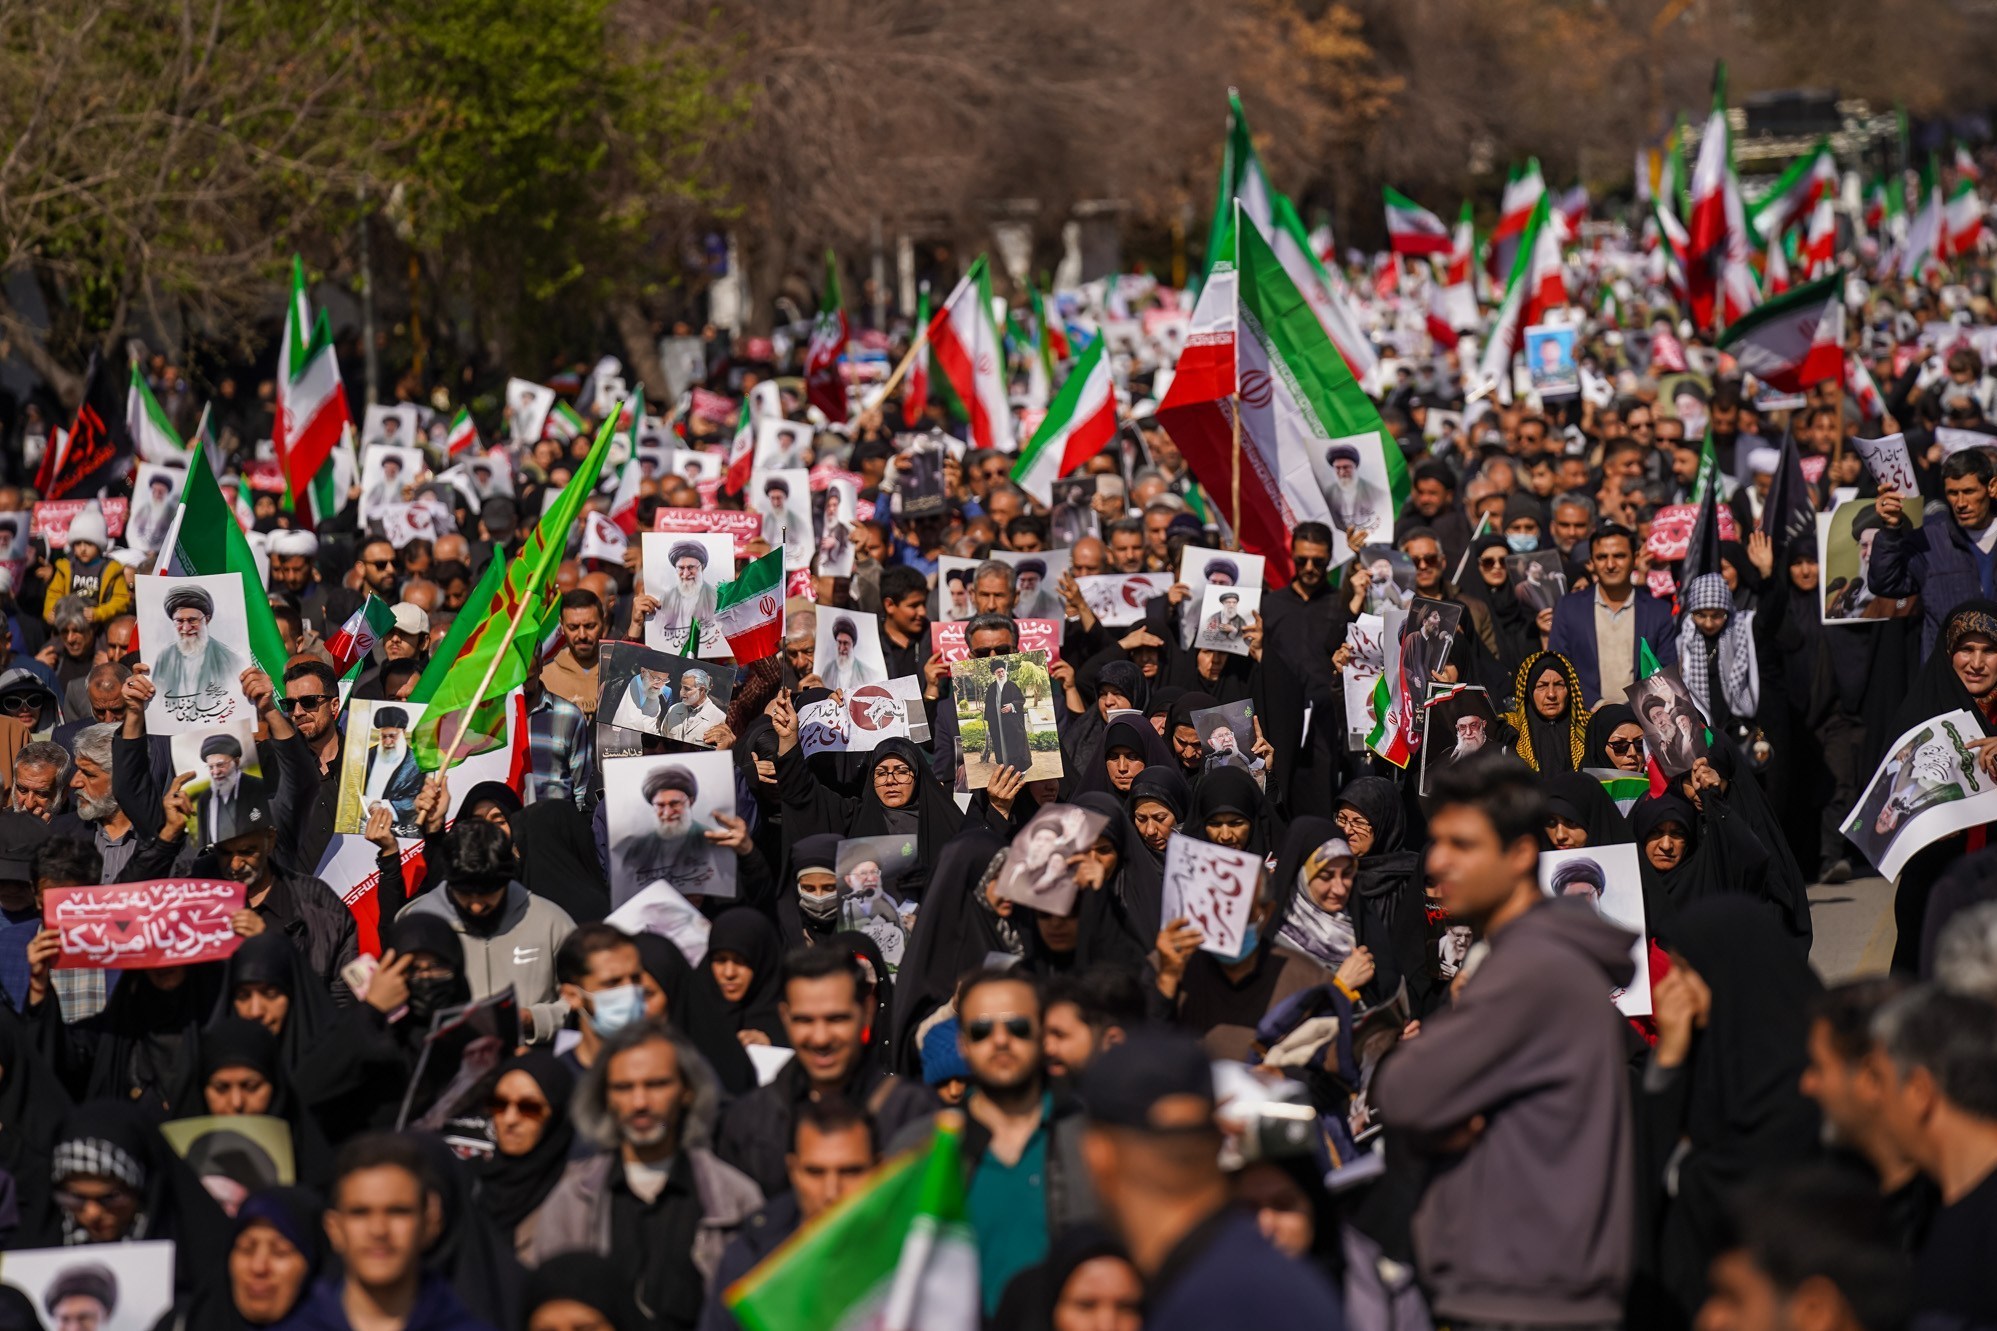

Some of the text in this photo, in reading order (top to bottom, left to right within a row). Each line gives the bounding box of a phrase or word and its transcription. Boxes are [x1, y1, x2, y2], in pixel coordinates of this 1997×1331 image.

[819, 703, 835, 718] خدا
[56, 891, 129, 920] تسلیم
[211, 885, 235, 898] نه
[59, 914, 154, 964] آمریکا
[174, 912, 236, 958] نبرد
